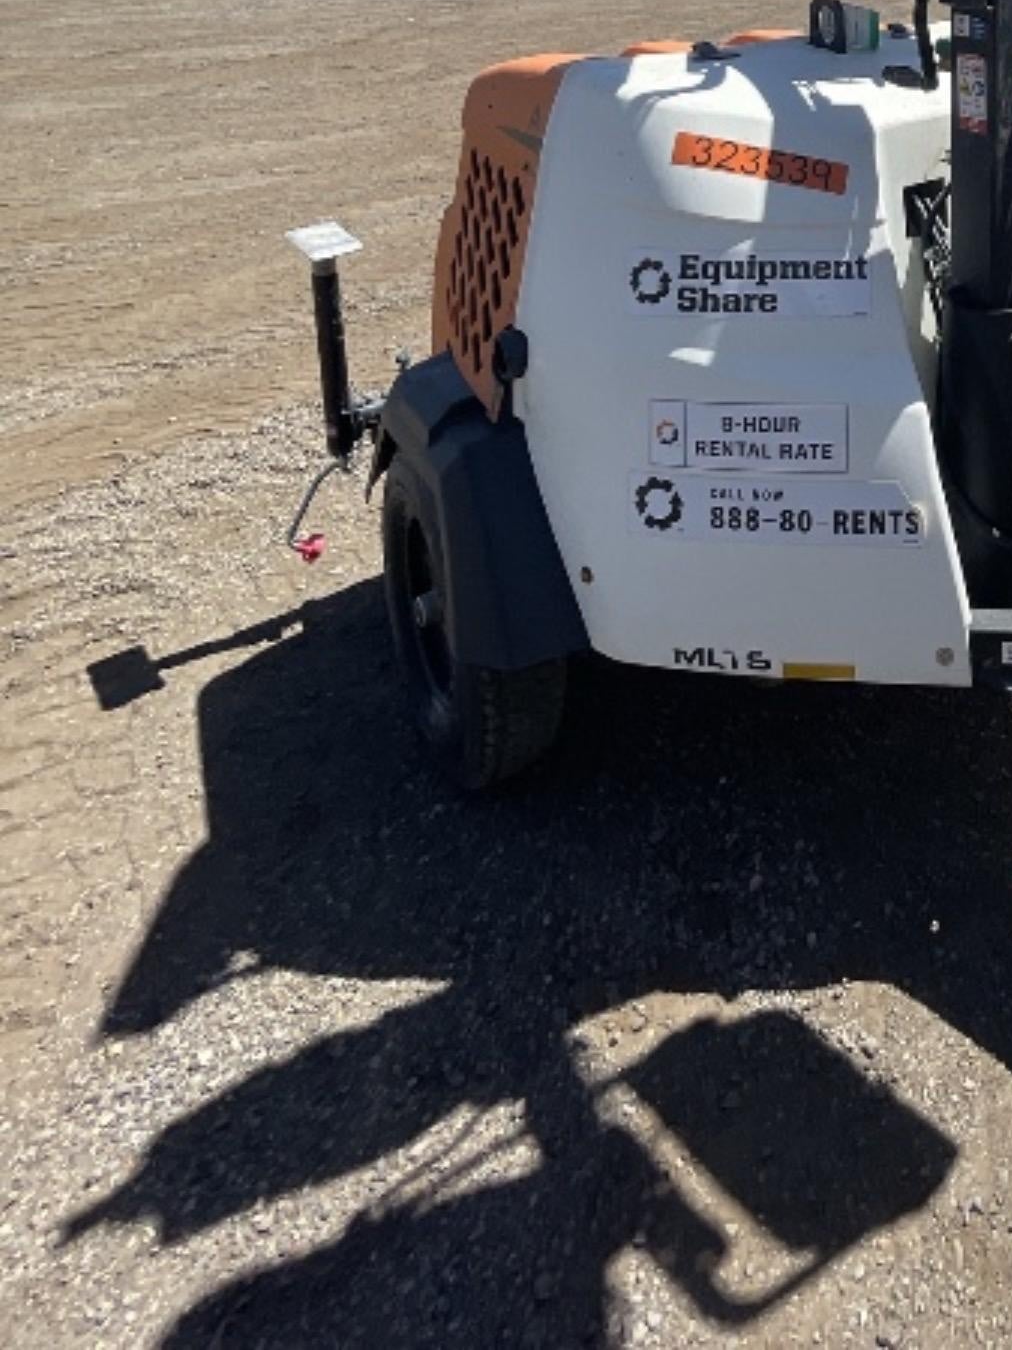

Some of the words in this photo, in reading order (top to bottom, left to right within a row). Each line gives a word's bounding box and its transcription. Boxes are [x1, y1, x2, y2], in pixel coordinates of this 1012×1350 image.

[691, 137, 832, 193] 323539
[677, 254, 868, 286] Equipment
[677, 286, 778, 313] Share
[721, 416, 801, 433] 8-HOUR
[695, 440, 772, 460] RENTAL
[779, 443, 834, 460] RATE
